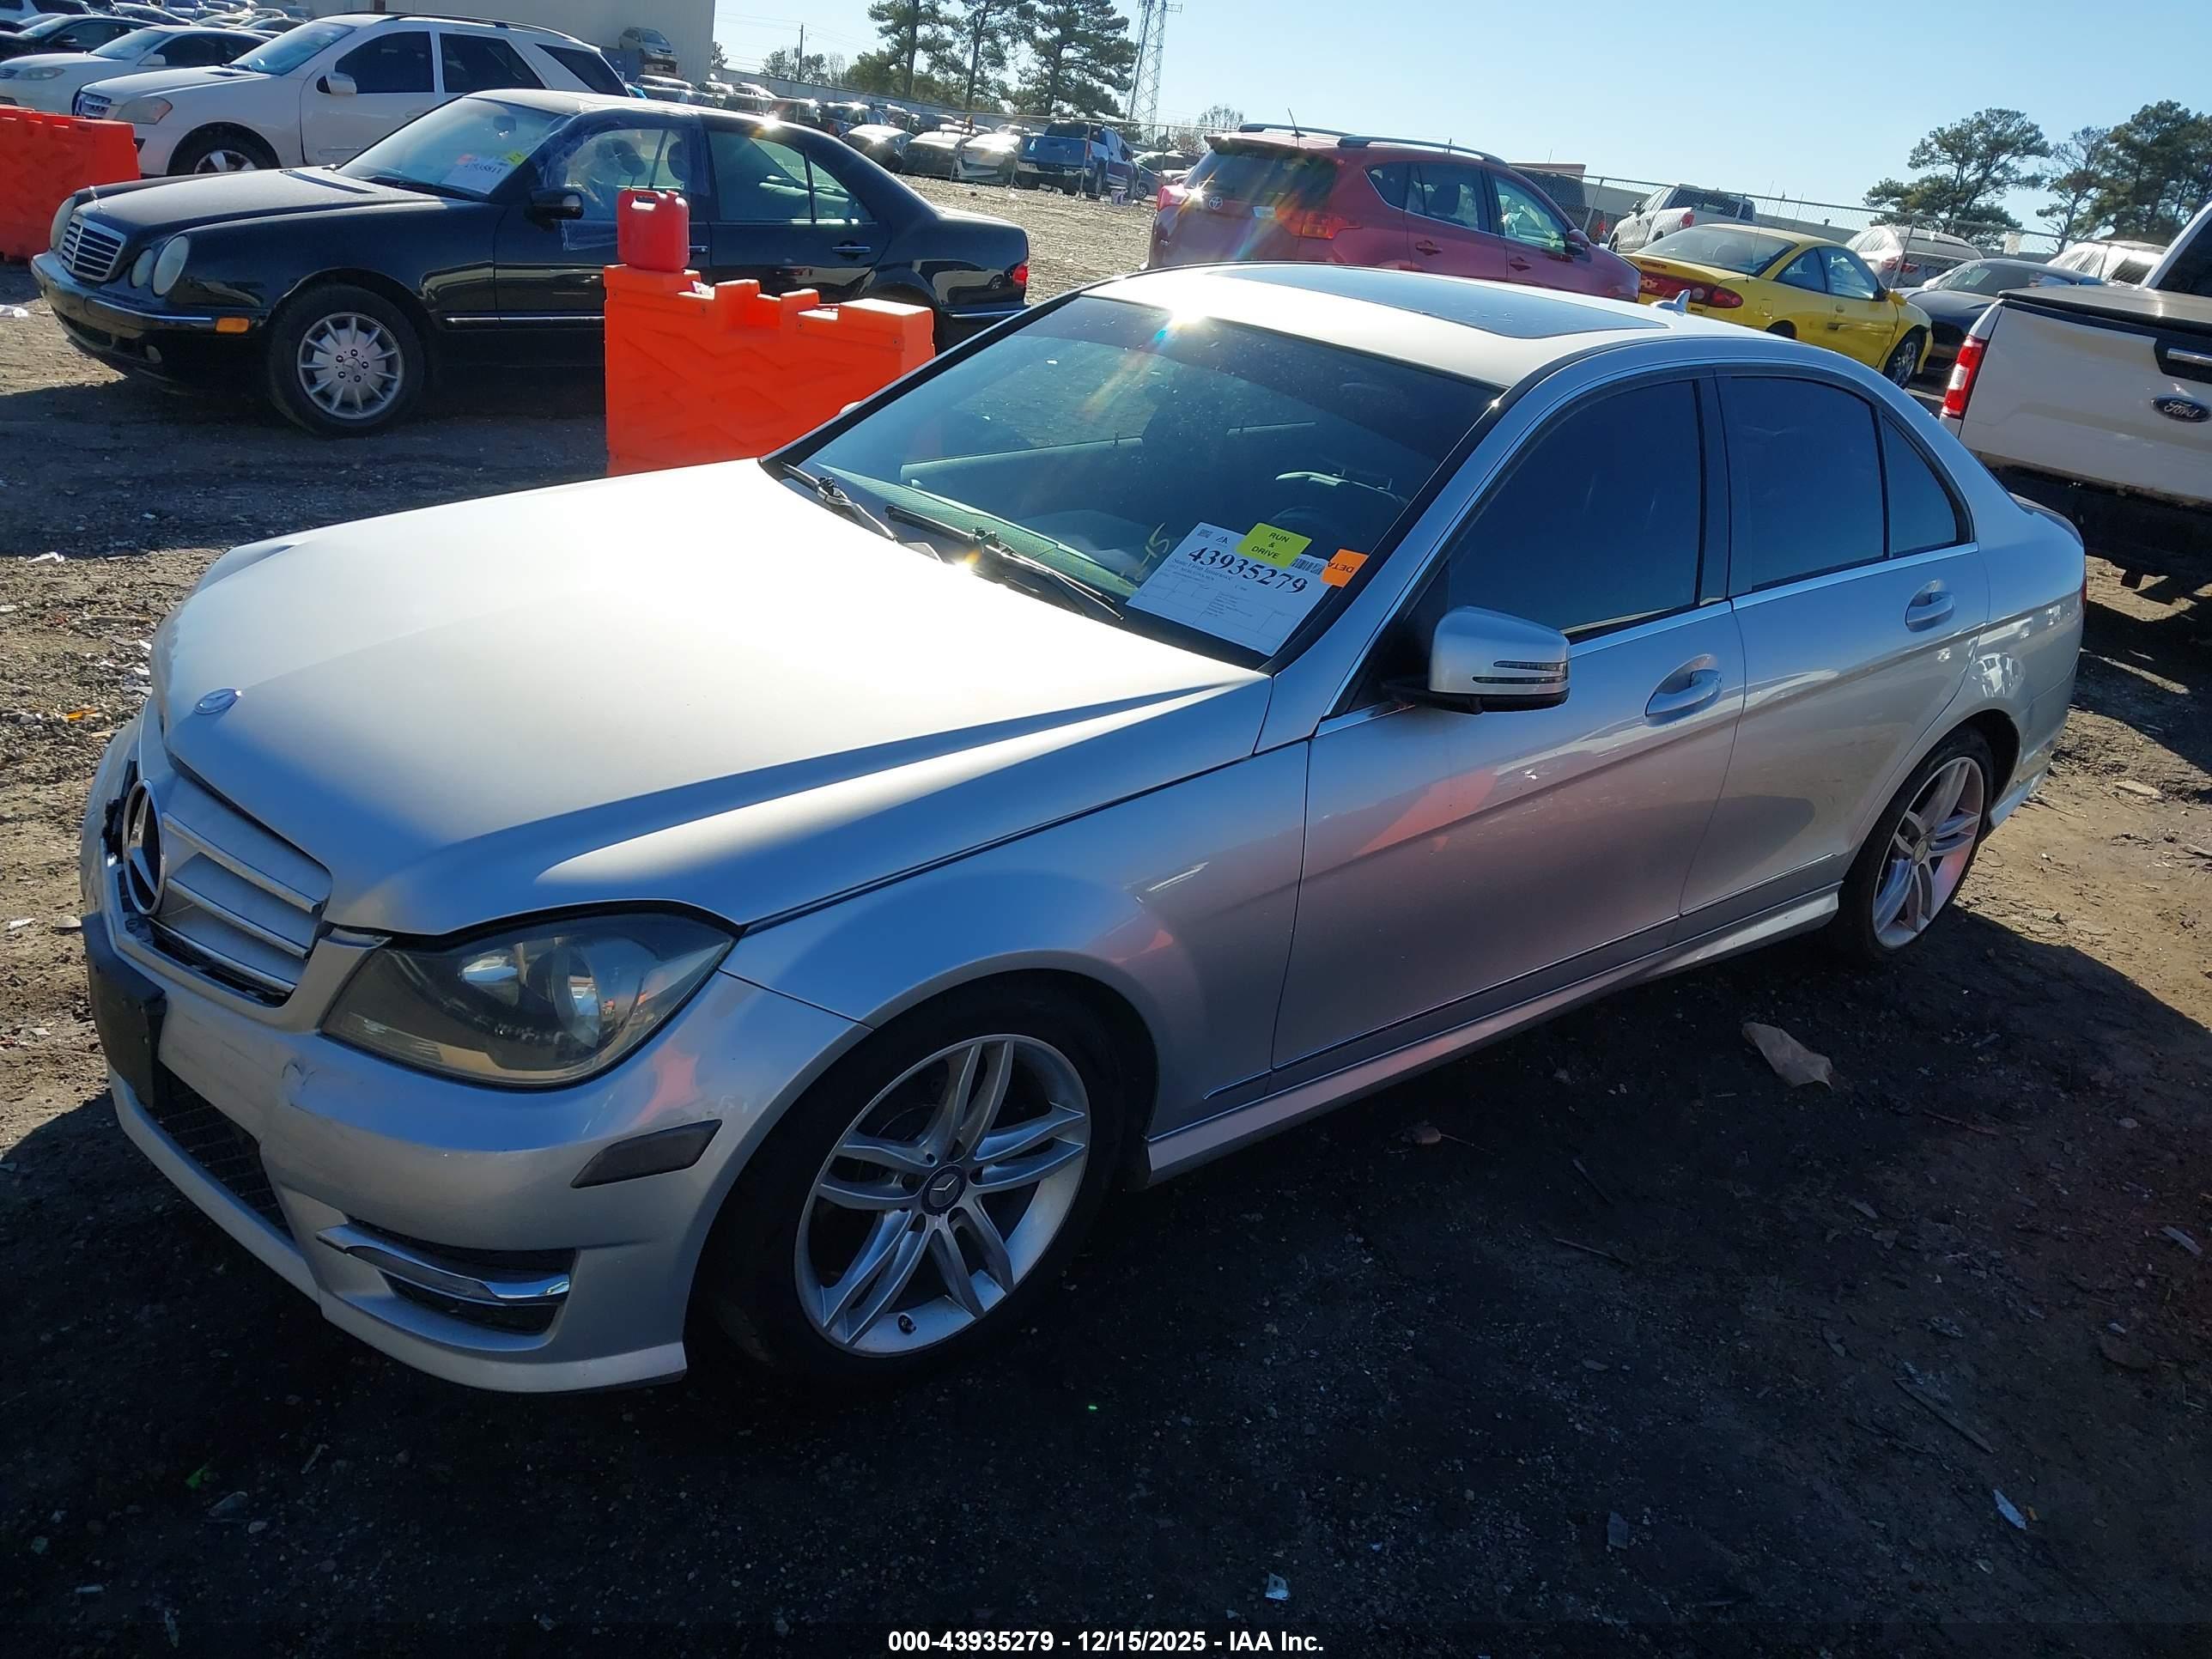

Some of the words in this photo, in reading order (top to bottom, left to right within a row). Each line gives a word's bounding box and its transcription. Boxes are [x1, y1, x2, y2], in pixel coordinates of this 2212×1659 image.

[2164, 400, 2199, 417] Ford
[1268, 532, 1290, 543] RUN
[1251, 545, 1280, 559] DRIVE
[1188, 547, 1308, 593] 43935279
[1328, 562, 1354, 573] DETA
